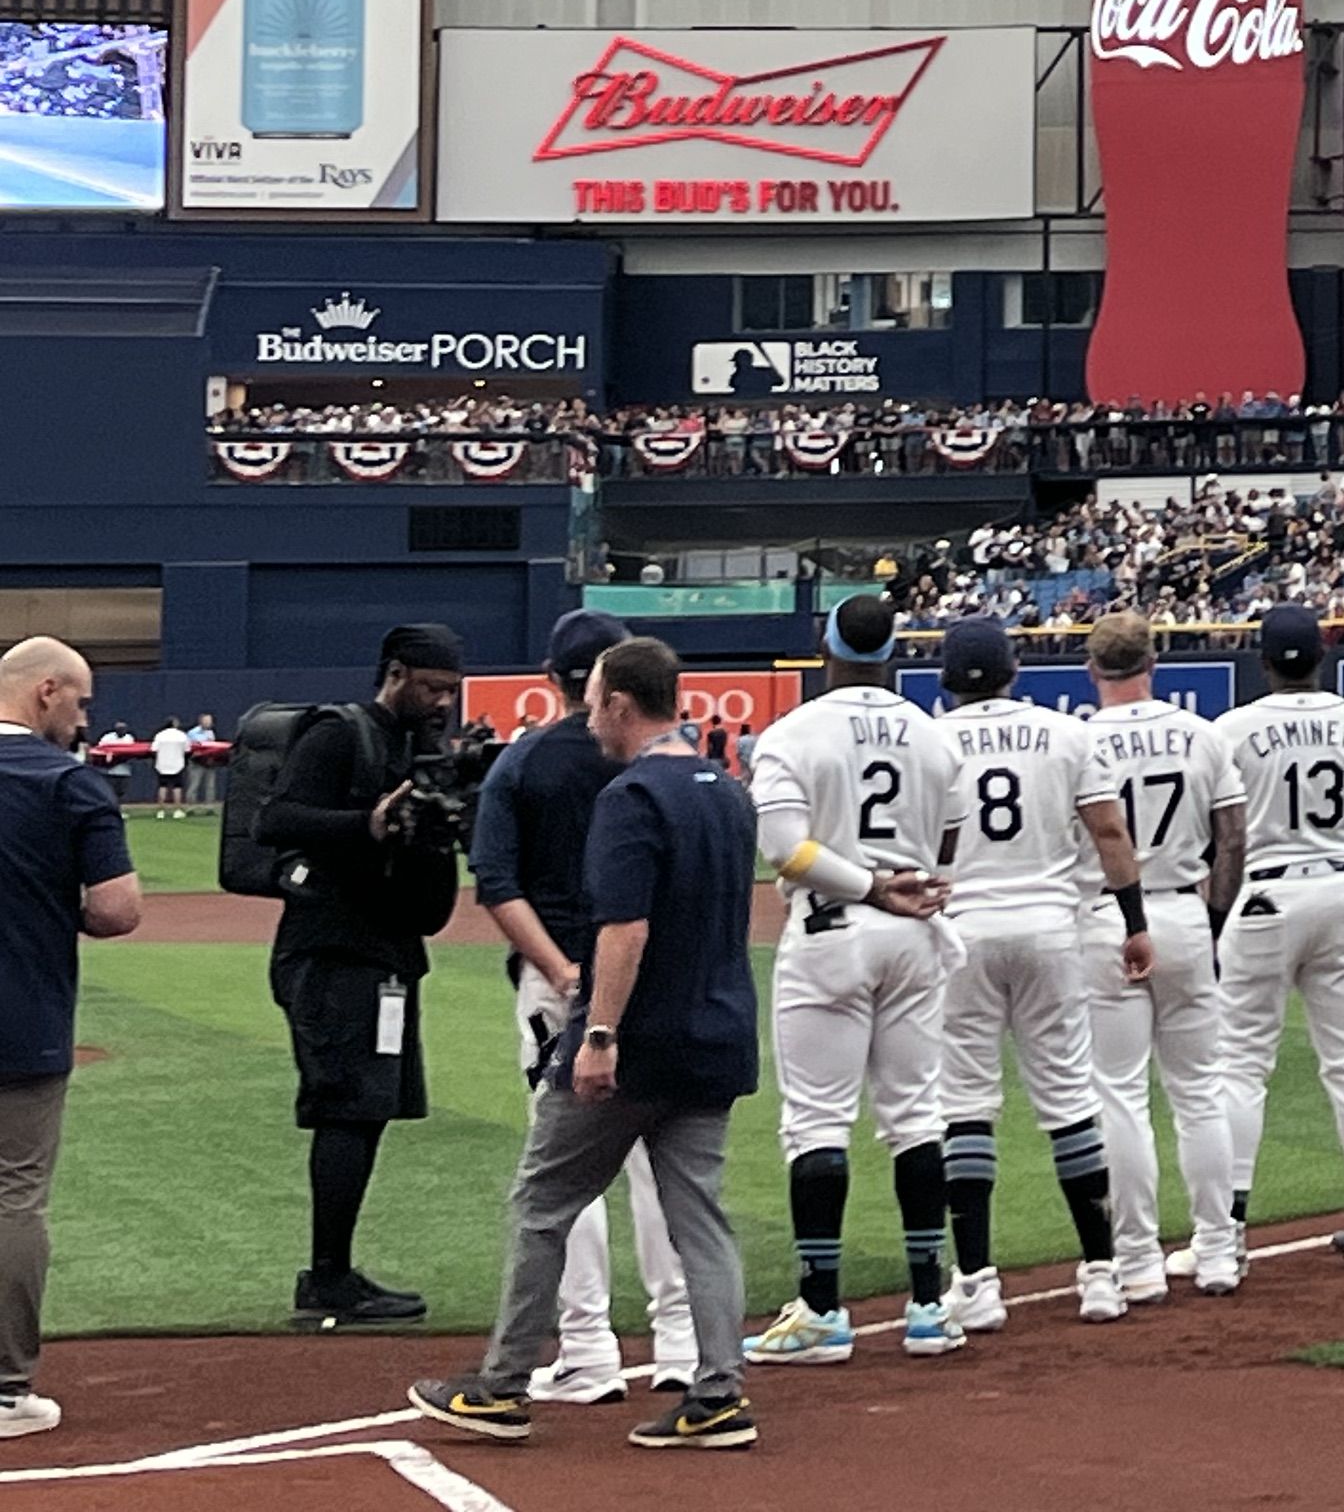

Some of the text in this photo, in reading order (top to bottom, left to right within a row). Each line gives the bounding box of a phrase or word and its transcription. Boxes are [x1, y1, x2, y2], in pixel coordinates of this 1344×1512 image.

[573, 70, 902, 131] Budweiser
[573, 181, 901, 214] THIS BUD'S FOR YOU.
[256, 333, 587, 370] Budweiser PORCH
[793, 340, 858, 357] BLACK
[793, 357, 878, 374] HISTORY
[791, 374, 880, 392] MATTERS
[857, 760, 901, 839] 2
[976, 767, 1023, 842] 8
[1119, 771, 1185, 849] 17
[1283, 760, 1344, 830] 13
